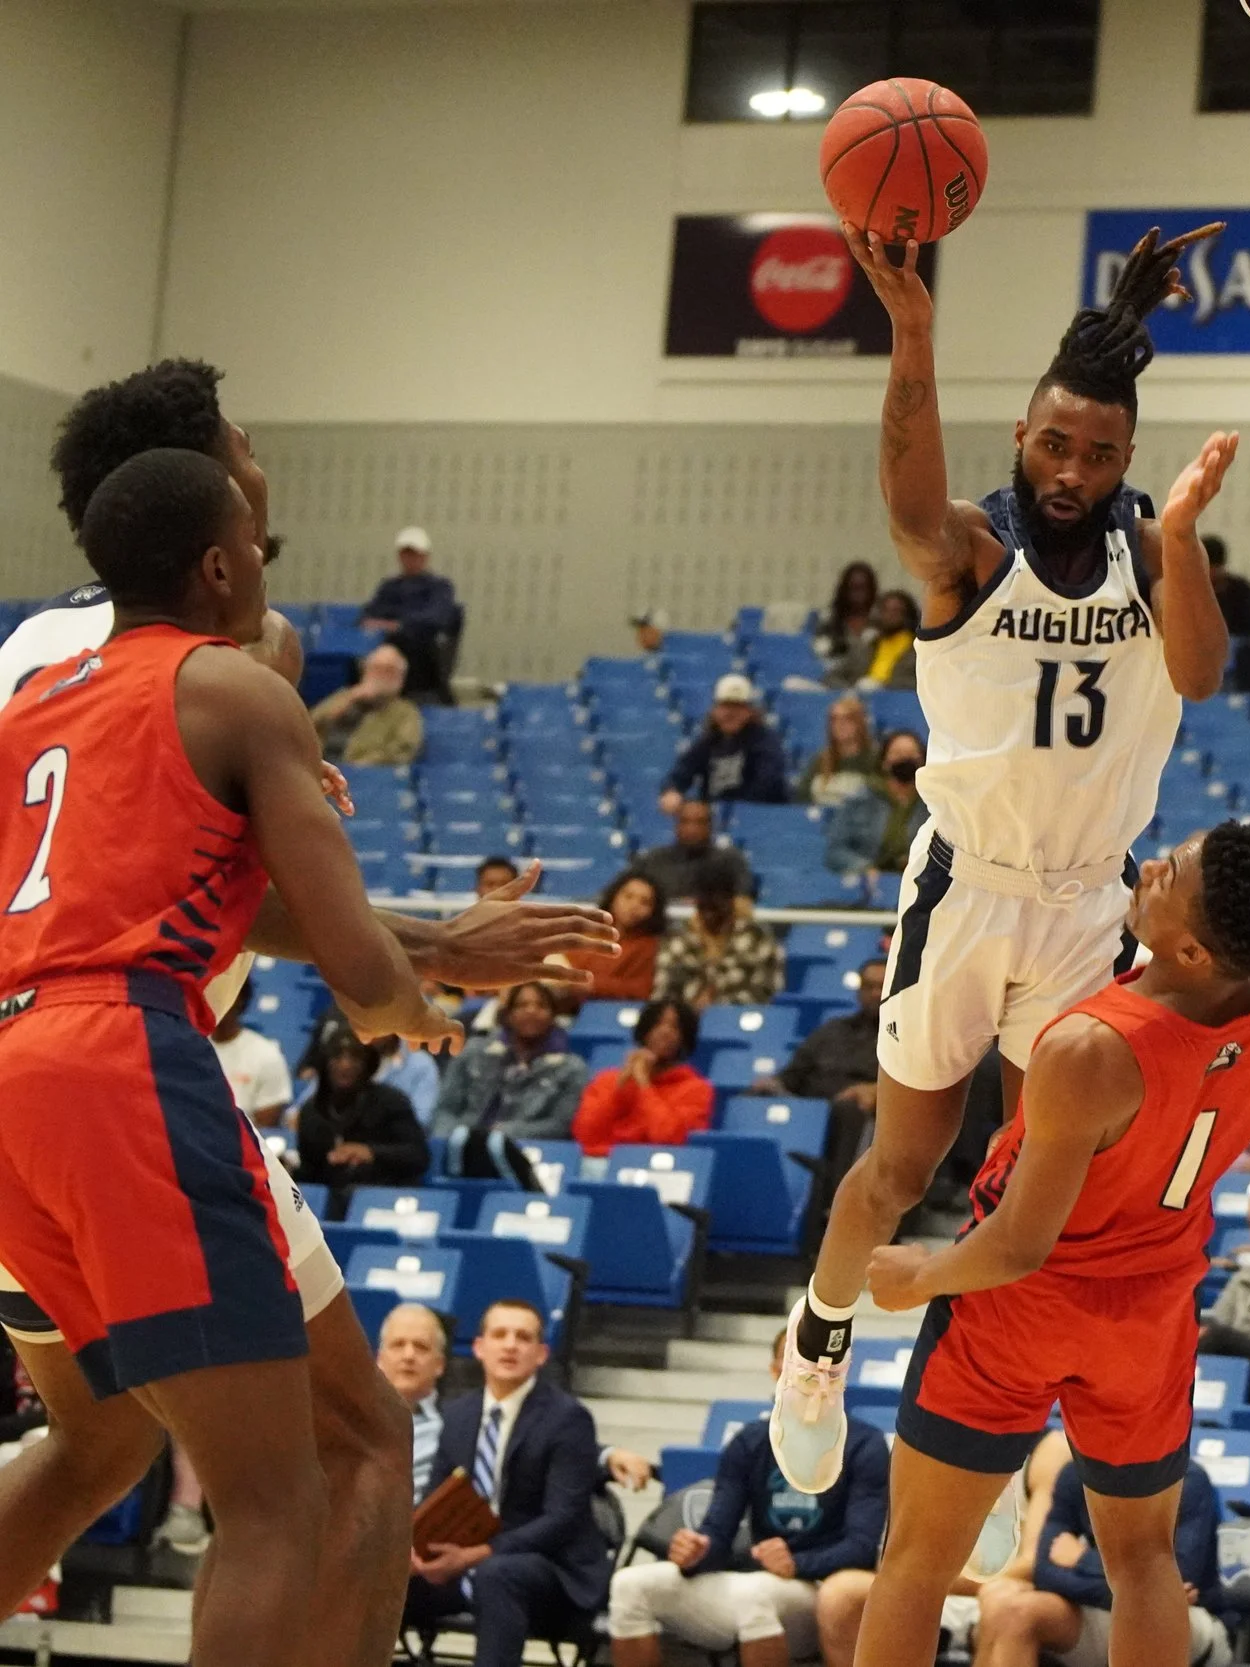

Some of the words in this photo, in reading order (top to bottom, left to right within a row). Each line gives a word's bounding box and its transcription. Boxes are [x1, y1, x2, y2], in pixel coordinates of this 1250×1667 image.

[990, 599, 1151, 646] AUGUSTA
[1033, 657, 1110, 749] 13
[6, 745, 68, 915] 2
[1159, 1109, 1218, 1210] 1
